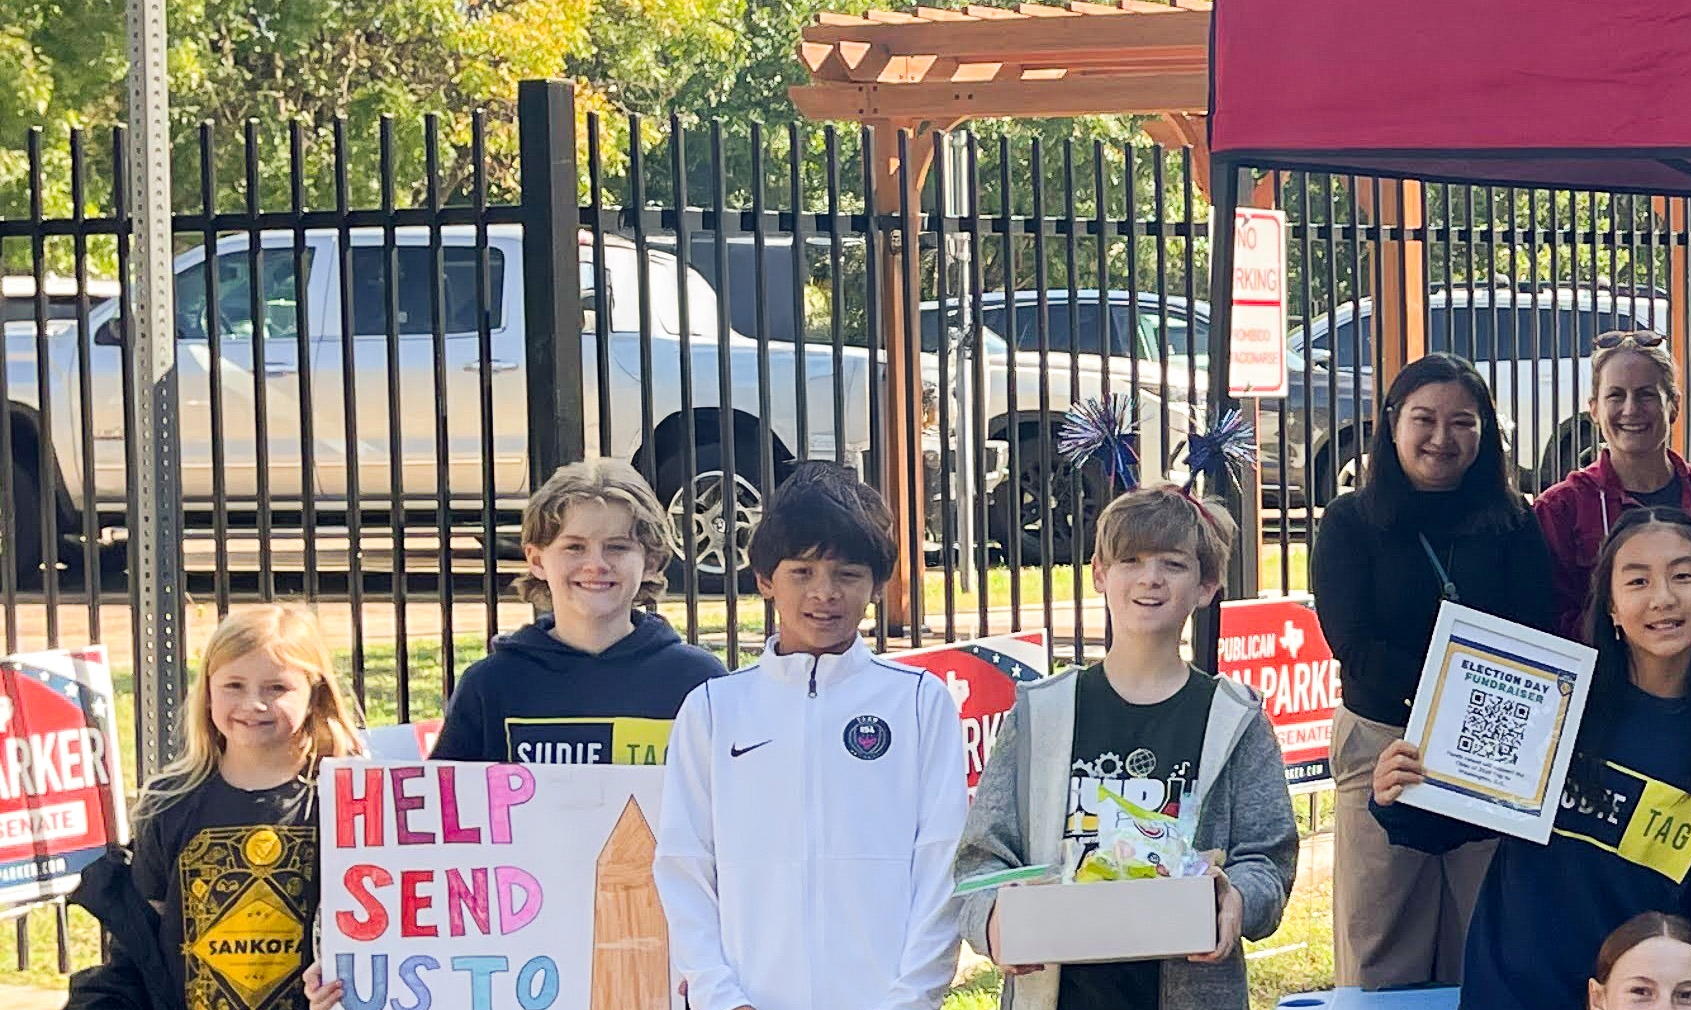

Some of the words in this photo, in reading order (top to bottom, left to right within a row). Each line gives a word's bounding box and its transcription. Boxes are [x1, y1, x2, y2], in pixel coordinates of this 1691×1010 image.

[1237, 227, 1257, 250] NO
[1235, 267, 1277, 291] RKING
[1218, 633, 1276, 663] PUBLICAN
[1261, 658, 1342, 716] PARKE
[1461, 660, 1521, 685] ELECTION
[1524, 680, 1550, 694] DAY
[1465, 671, 1544, 704] FUNDRAISER
[0, 727, 109, 800] RKER
[626, 742, 669, 765] TA
[334, 764, 536, 848] HELP
[335, 864, 543, 941] SEND
